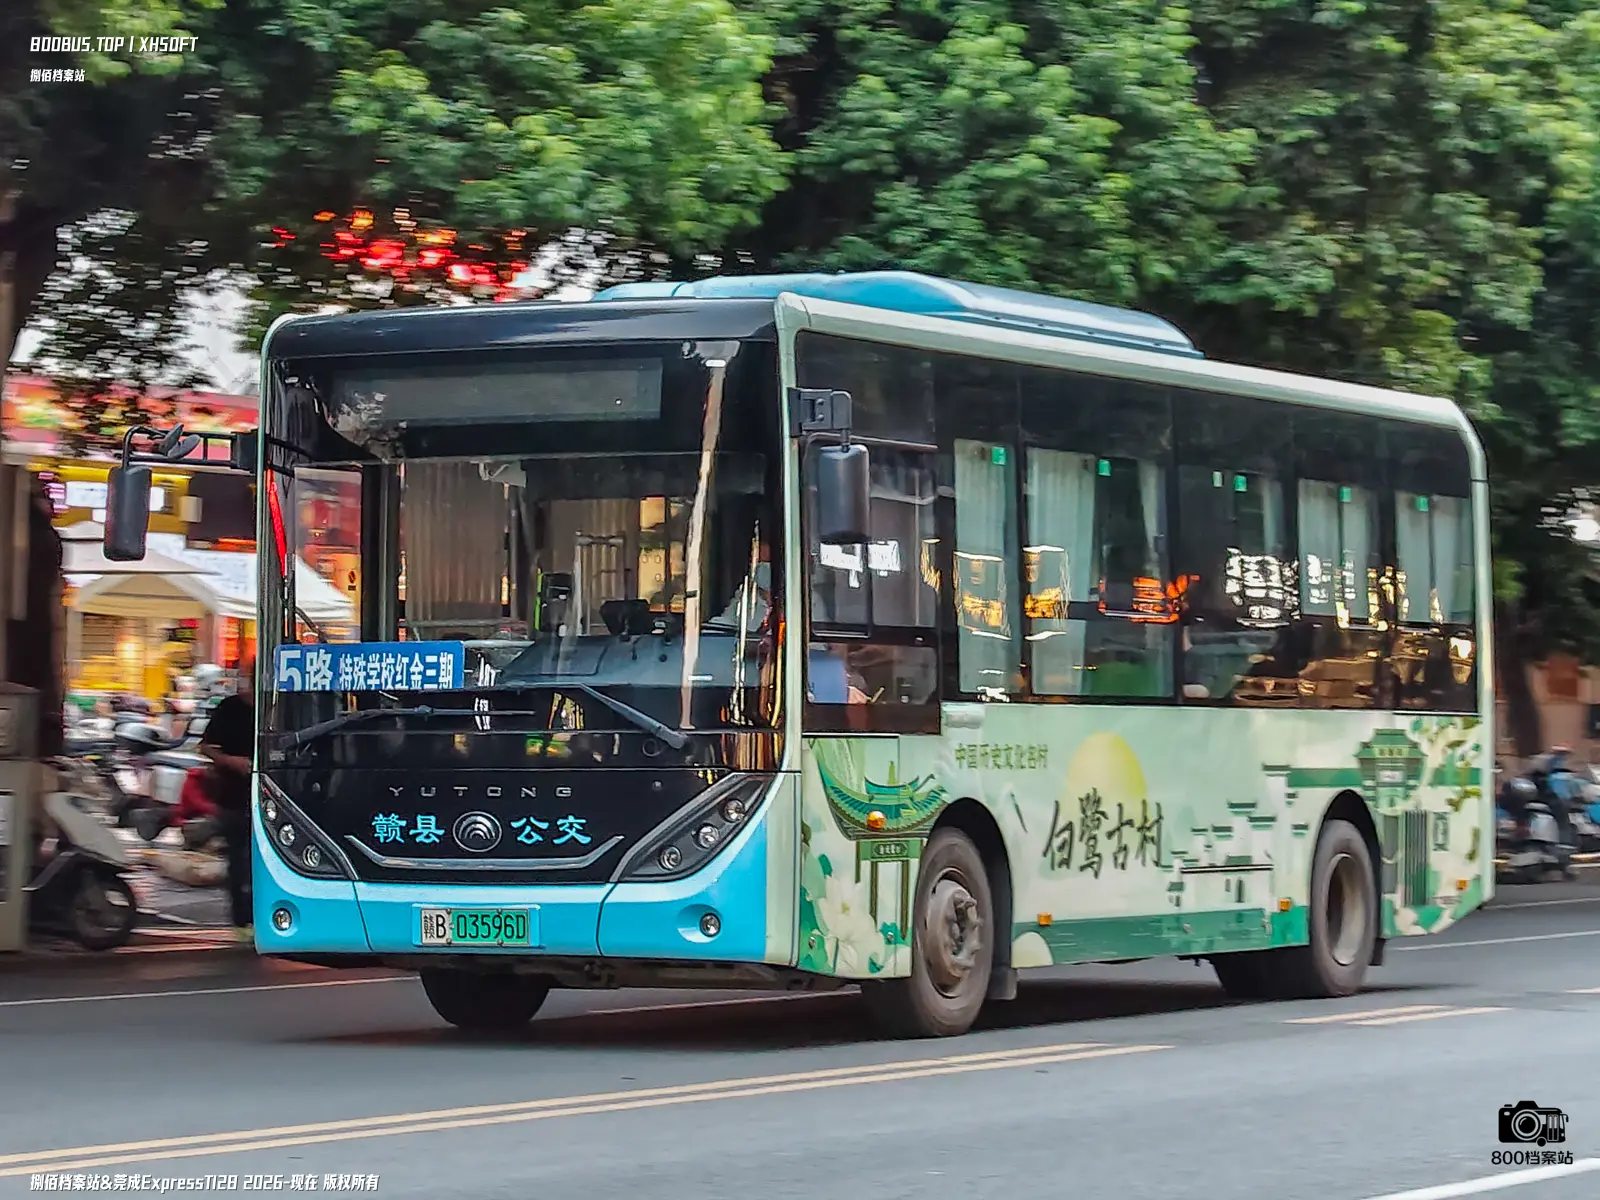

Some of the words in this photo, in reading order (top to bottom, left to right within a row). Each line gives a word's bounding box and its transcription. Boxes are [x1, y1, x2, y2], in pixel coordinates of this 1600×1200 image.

[279, 648, 333, 691] 5路
[389, 786, 572, 797] YUTONG
[371, 813, 446, 844] 赣县
[510, 814, 592, 845] 公交
[1042, 787, 1164, 879] 白鹭古村
